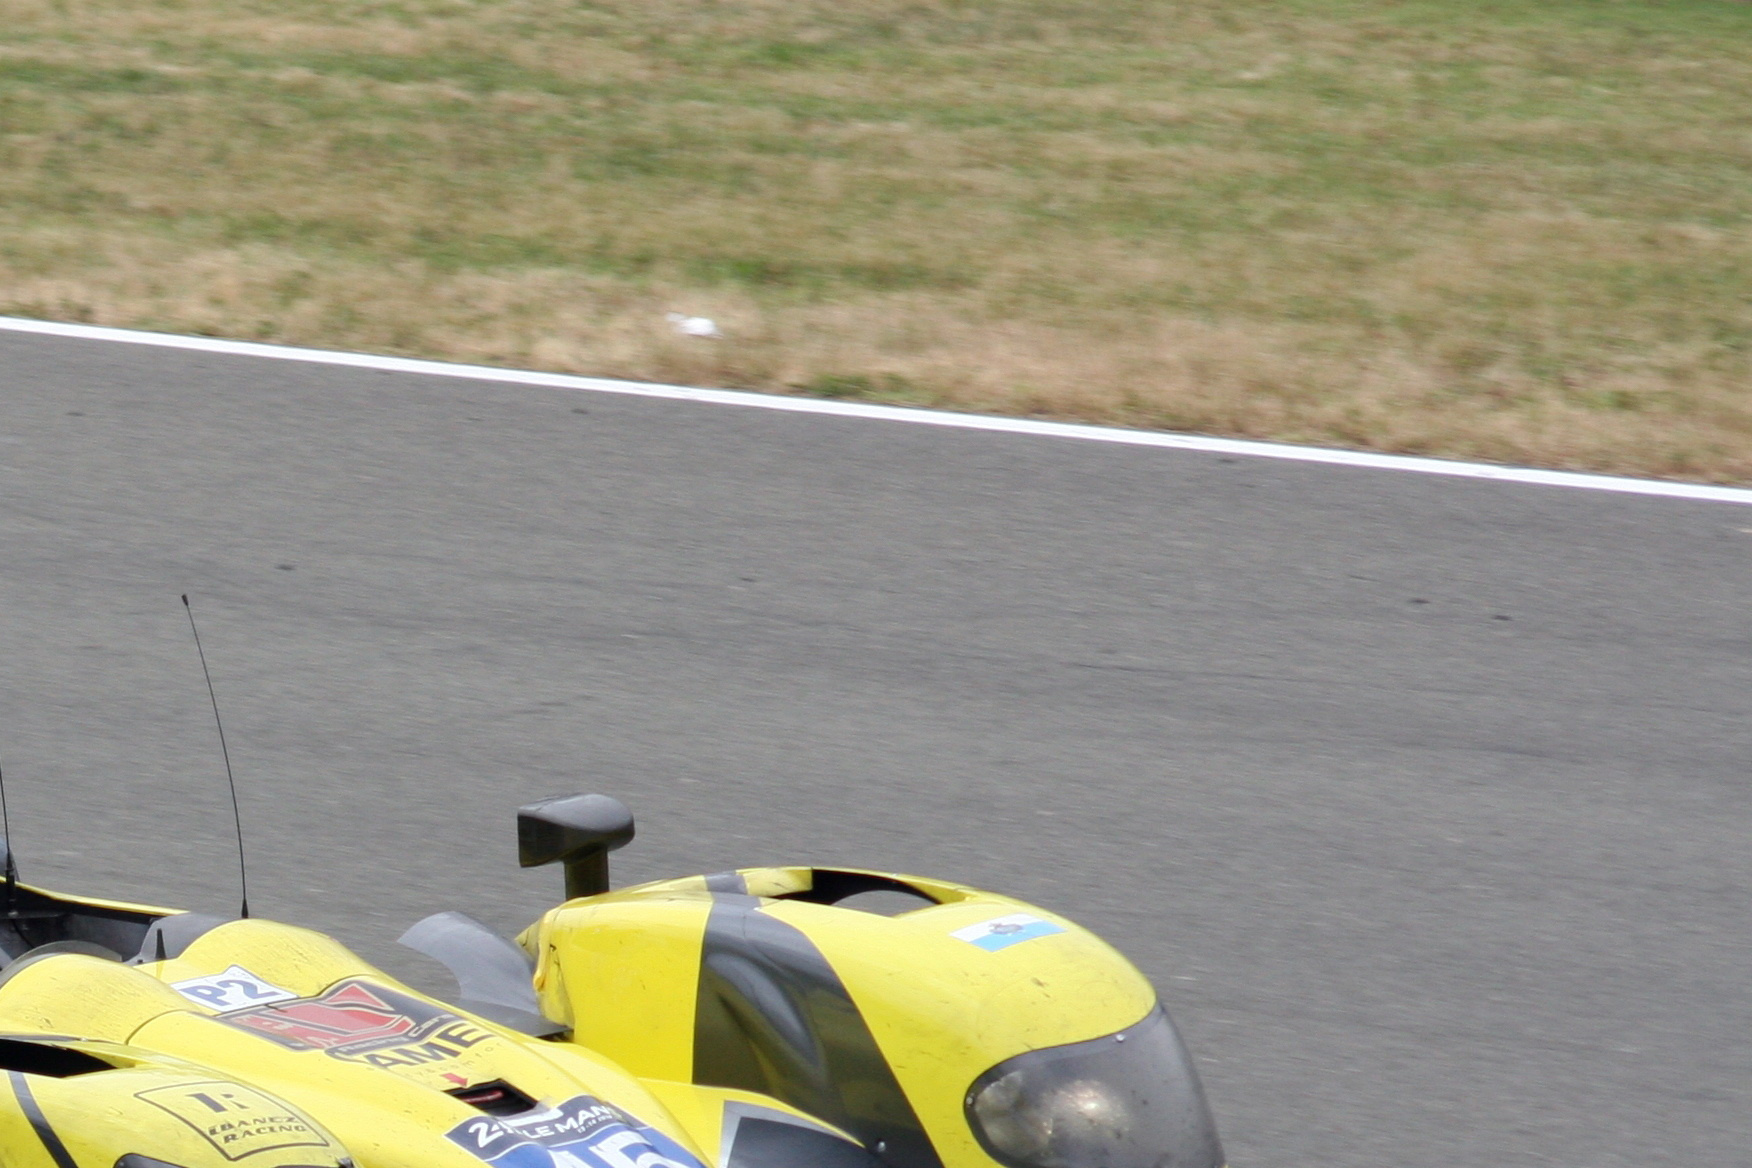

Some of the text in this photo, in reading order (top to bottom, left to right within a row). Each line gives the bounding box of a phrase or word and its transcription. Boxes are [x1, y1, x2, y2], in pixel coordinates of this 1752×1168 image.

[179, 979, 282, 1006] P2
[361, 1019, 497, 1069] AME
[223, 1124, 307, 1144] RACING
